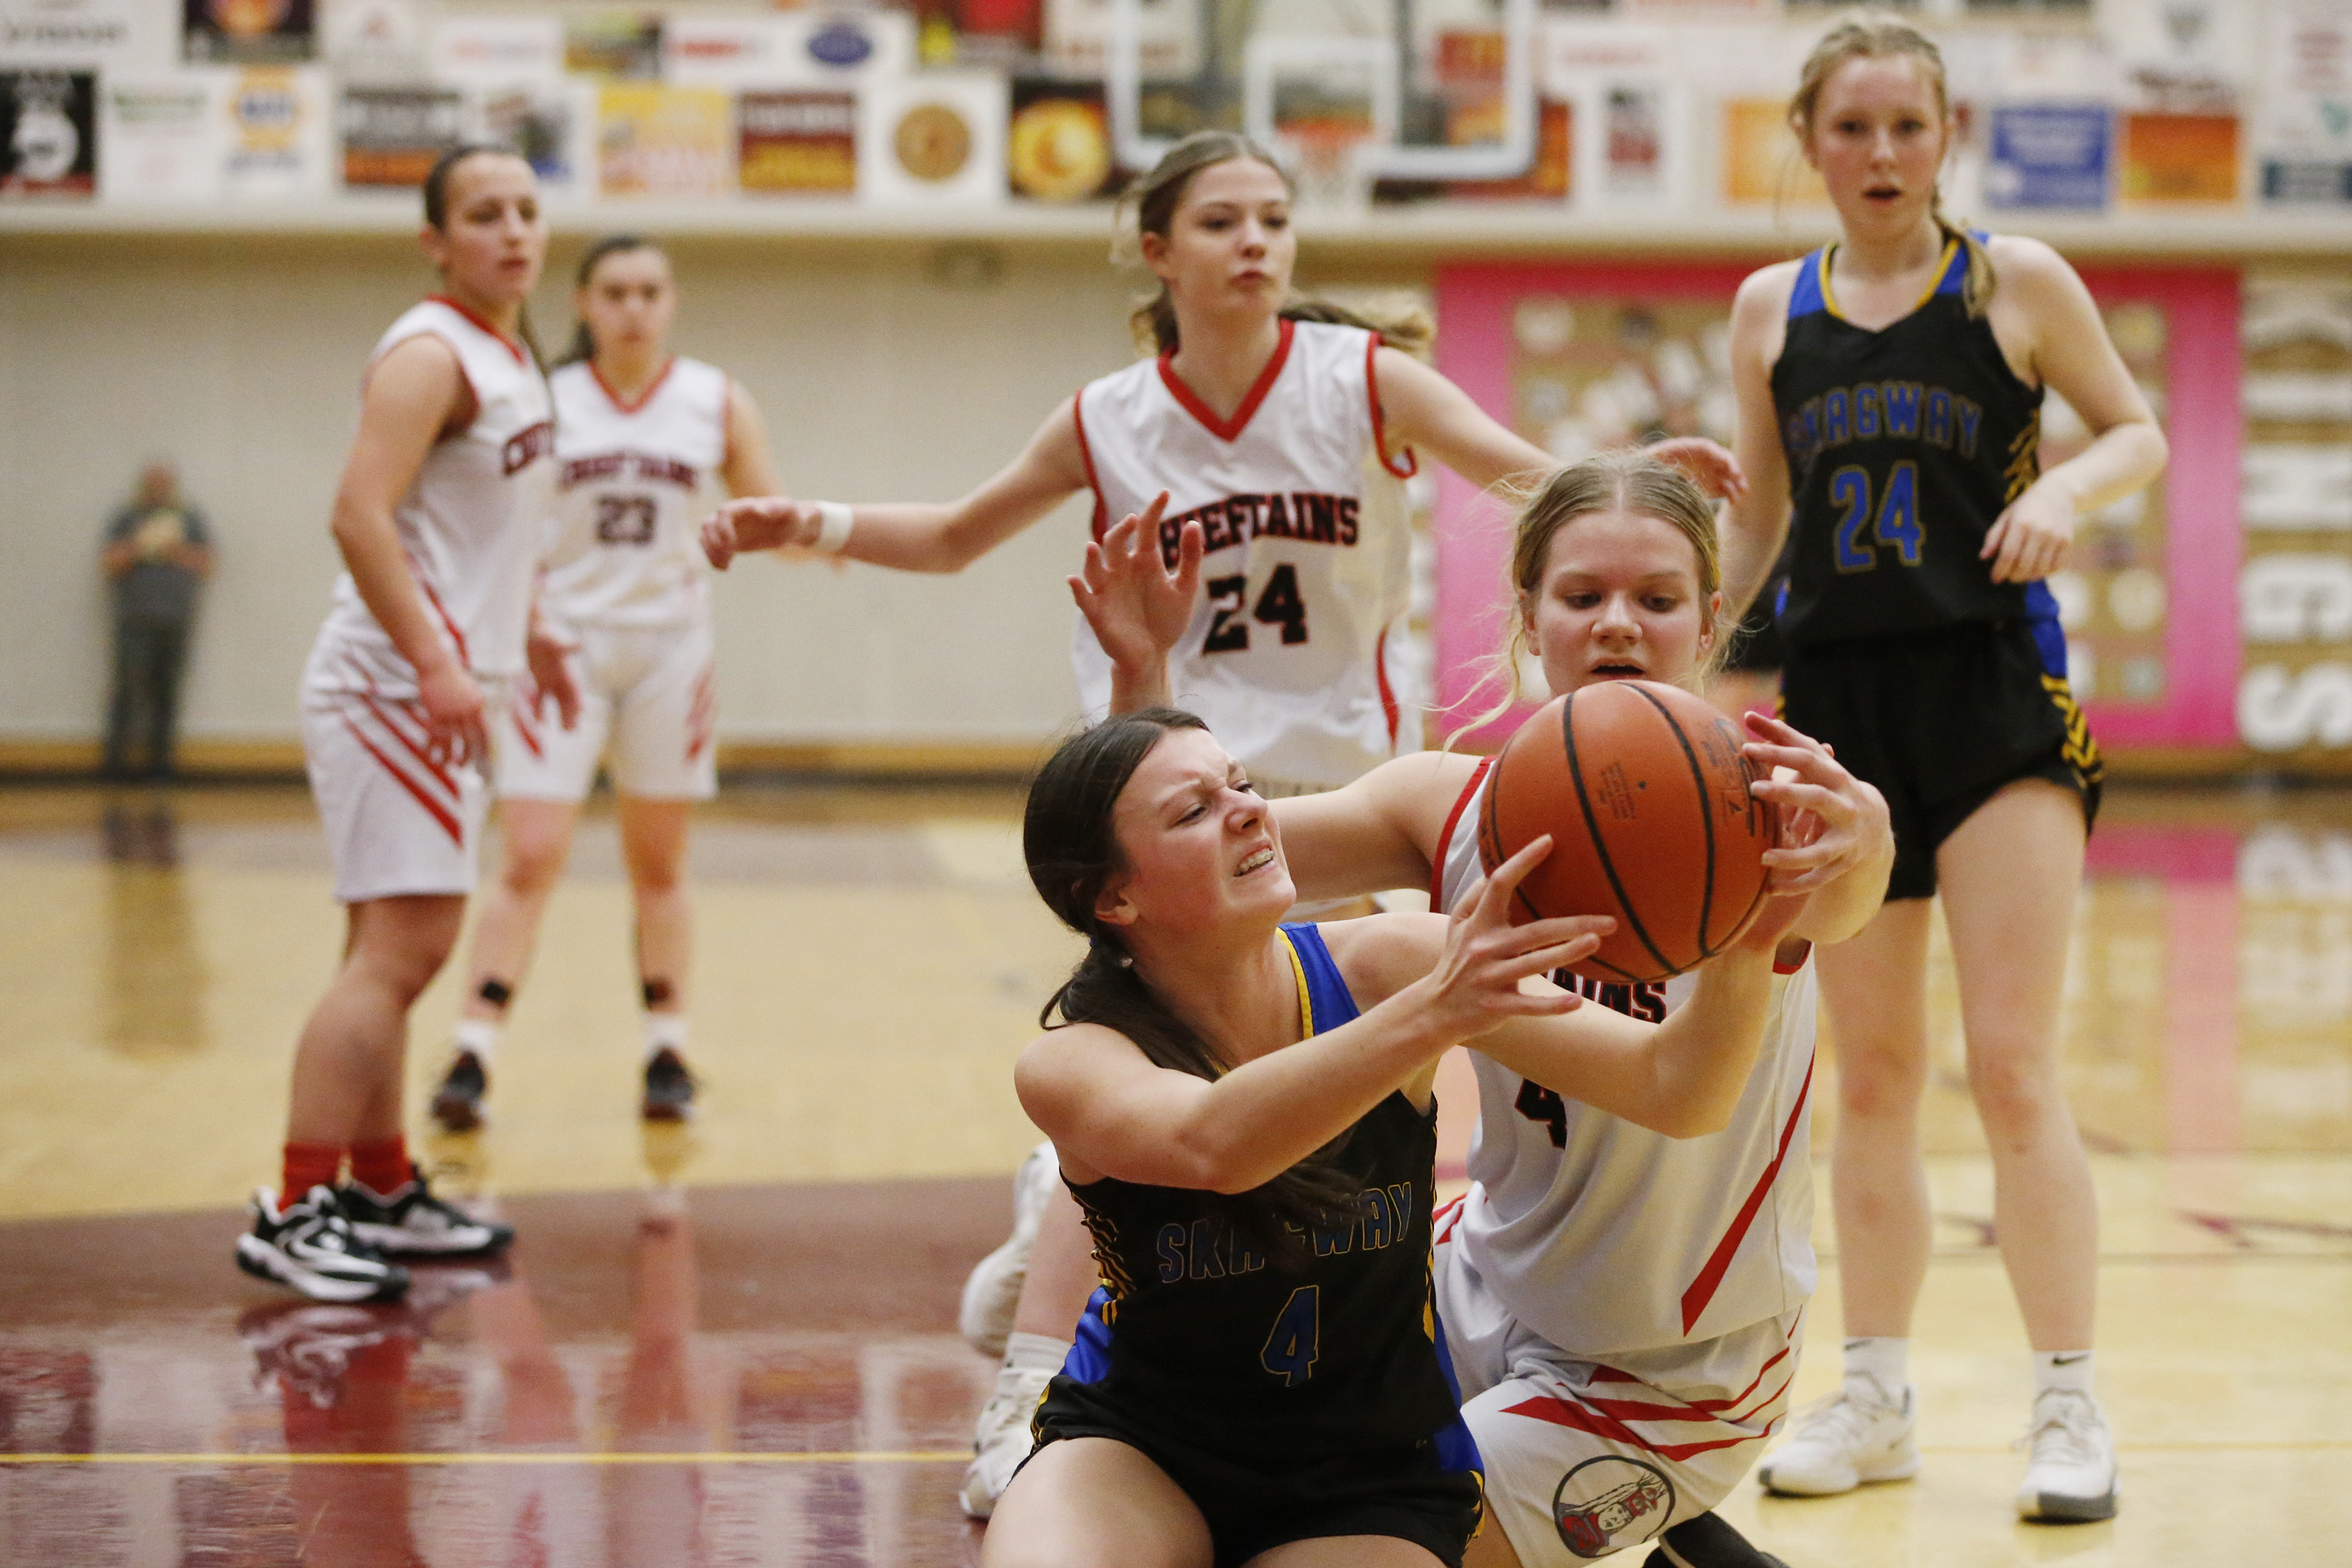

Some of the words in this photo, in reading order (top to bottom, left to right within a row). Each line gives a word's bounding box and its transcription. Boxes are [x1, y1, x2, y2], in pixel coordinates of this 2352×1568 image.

[1830, 459, 1926, 574] 24
[1203, 562, 1309, 655] 24
[1260, 1284, 1319, 1387] 4
